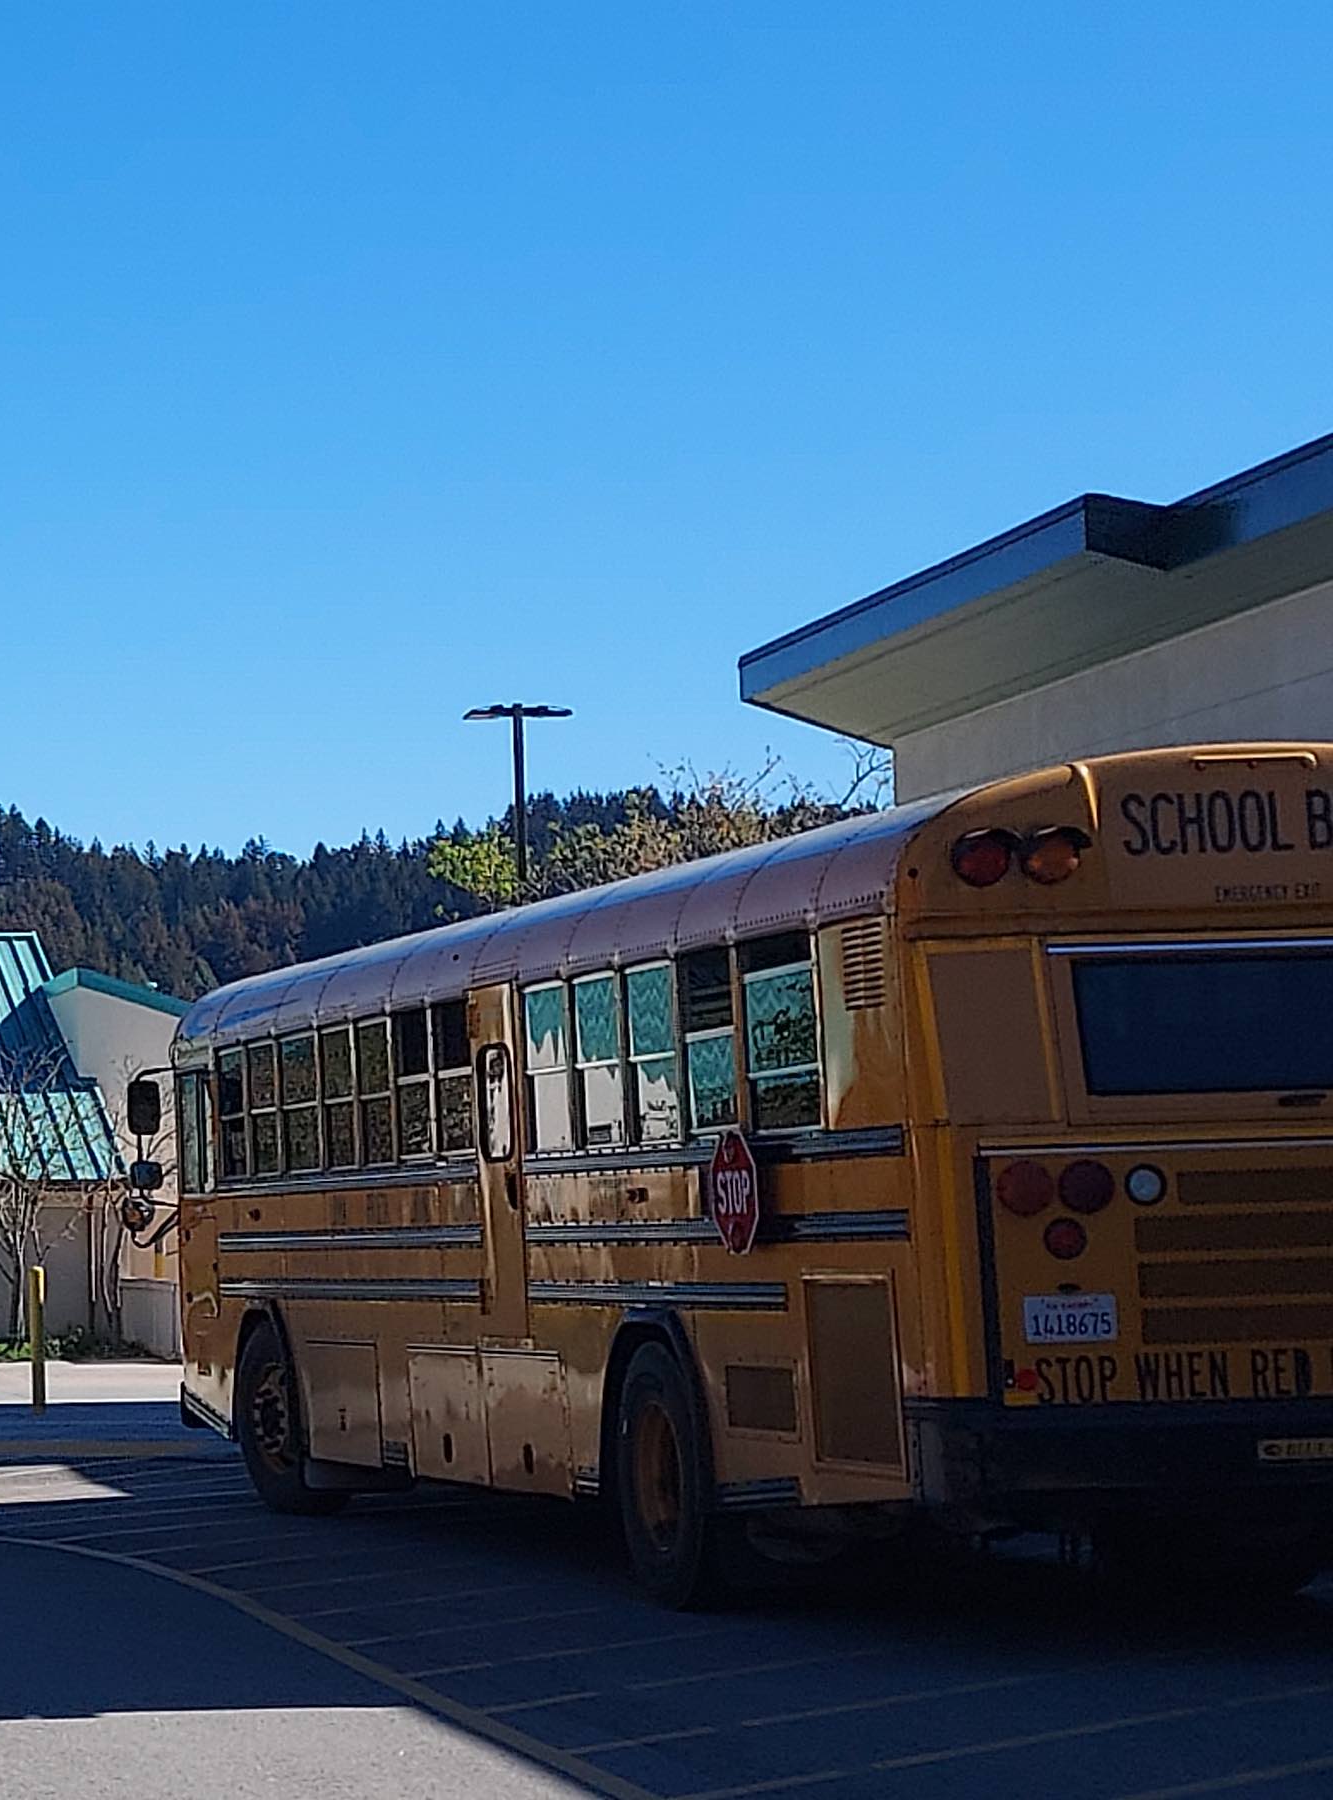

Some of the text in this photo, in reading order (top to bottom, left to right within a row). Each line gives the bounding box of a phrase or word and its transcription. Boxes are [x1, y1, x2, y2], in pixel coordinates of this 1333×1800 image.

[1121, 790, 1294, 855] SCHOOL
[1214, 881, 1321, 902] EMERGENCY EXIT
[717, 1169, 750, 1215] STOP
[1032, 1312, 1112, 1336] 1418675
[1036, 1355, 1117, 1402] STOP
[1134, 1350, 1229, 1398] WHEN
[1251, 1348, 1313, 1396] RED
